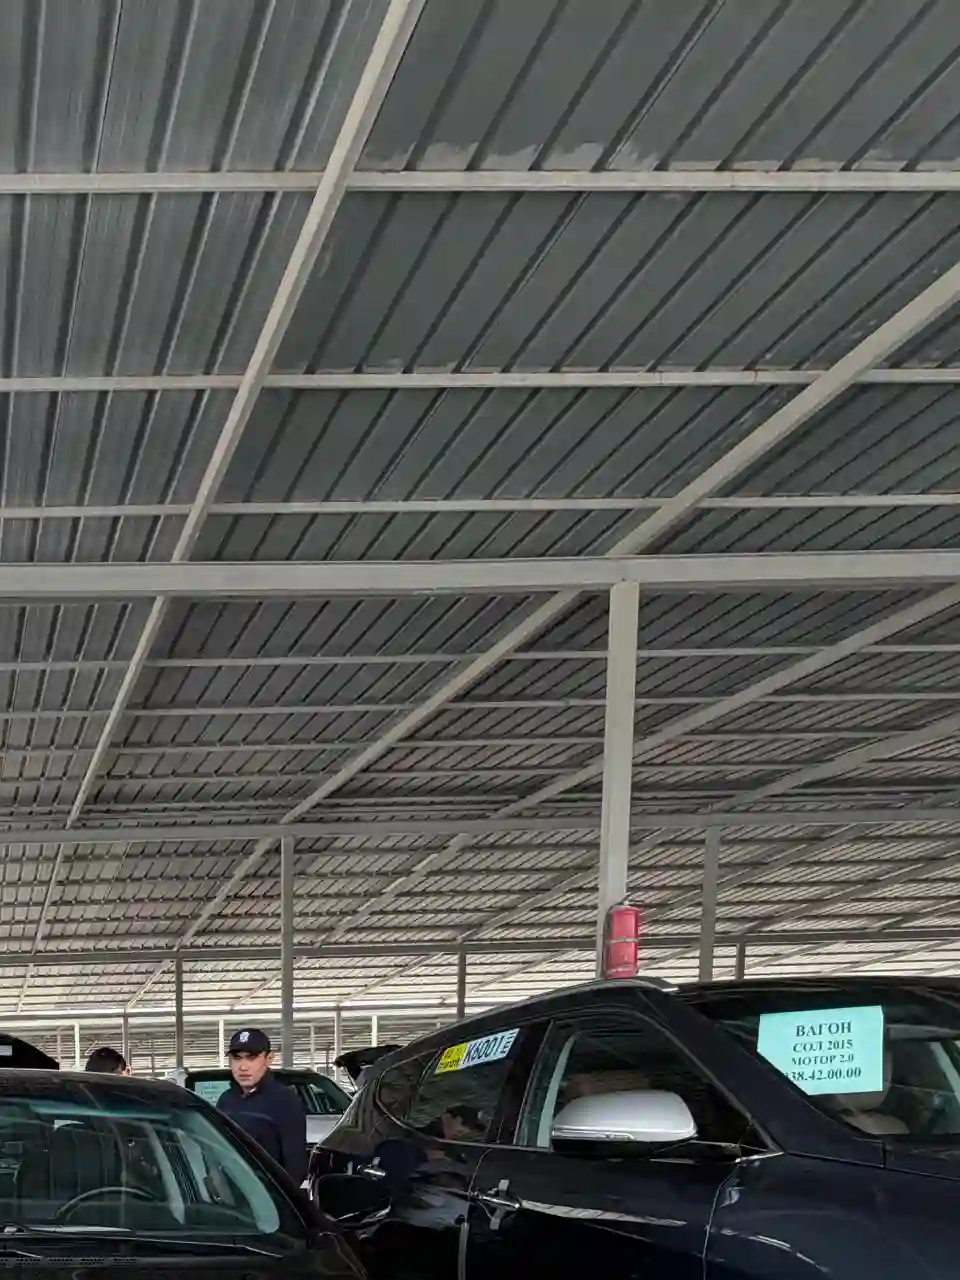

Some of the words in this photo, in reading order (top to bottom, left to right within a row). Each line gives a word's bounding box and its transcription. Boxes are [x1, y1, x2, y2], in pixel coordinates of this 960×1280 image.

[796, 1020, 852, 1037] ВАГОН
[792, 1040, 823, 1053] СОЛ
[827, 1039, 854, 1051] 2015
[792, 1054, 836, 1066] МОТОР
